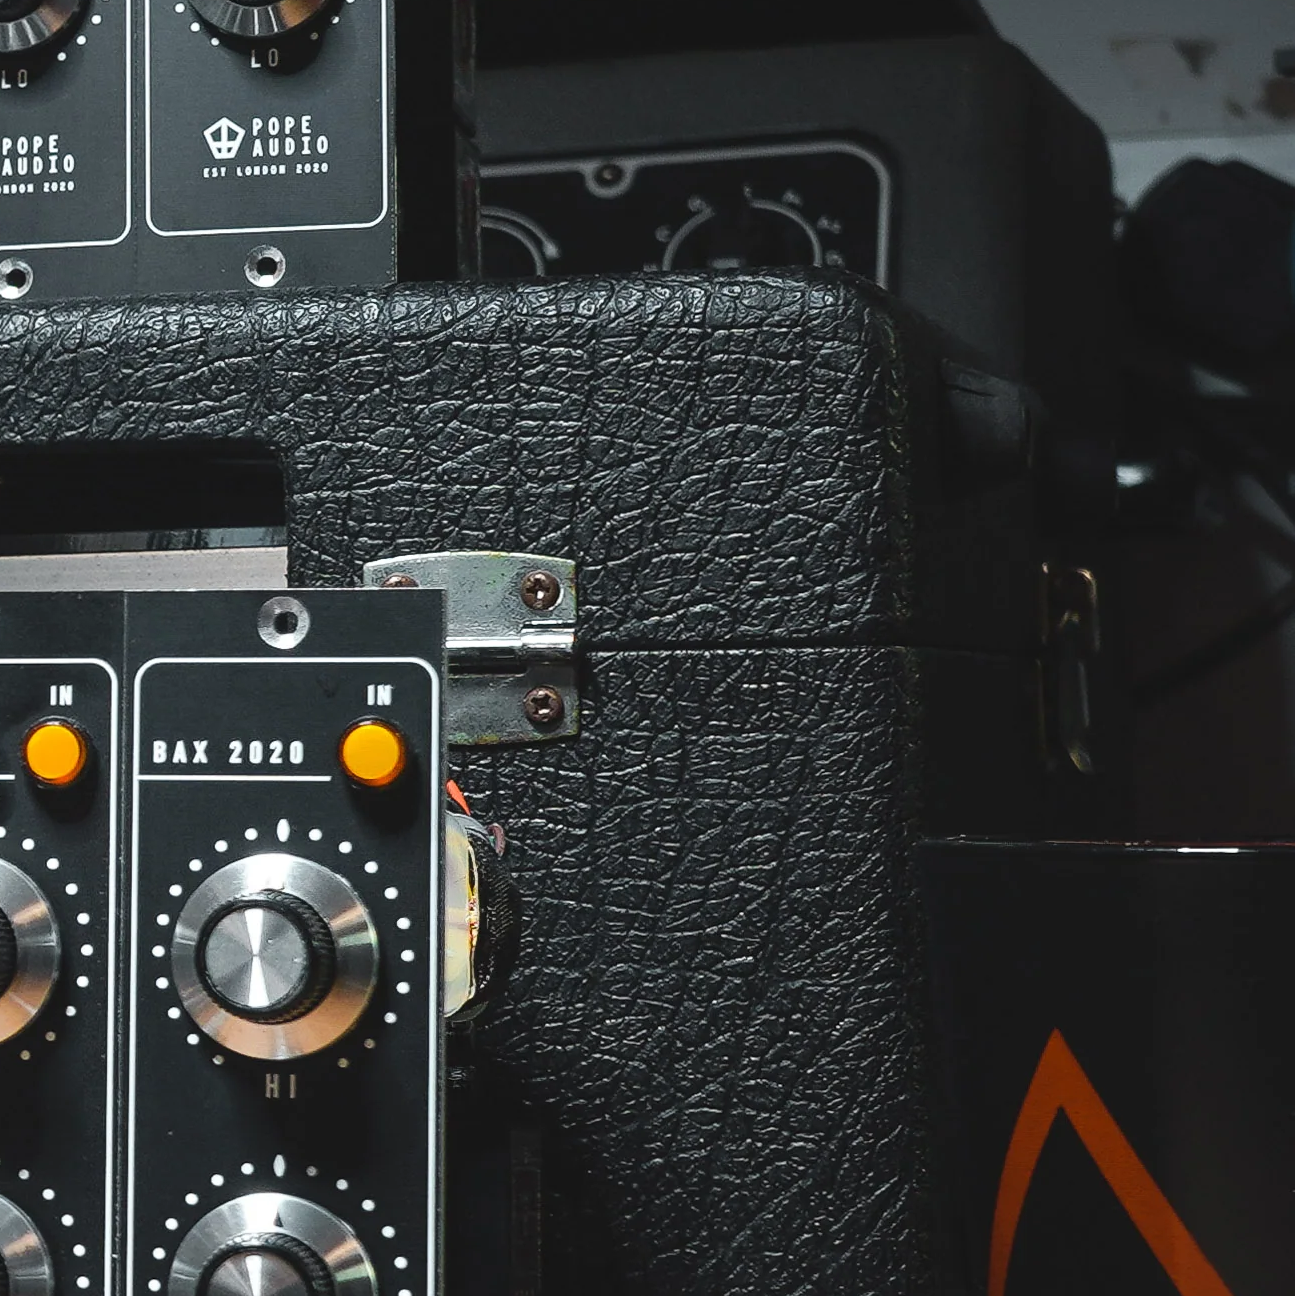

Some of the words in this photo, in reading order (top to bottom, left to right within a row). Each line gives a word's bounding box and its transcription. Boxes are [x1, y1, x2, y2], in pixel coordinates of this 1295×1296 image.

[250, 47, 279, 69] LO
[0, 68, 28, 90] LO
[252, 115, 312, 137] POPE
[2, 134, 59, 156] POPE
[252, 135, 329, 158] AUDIO
[1, 153, 75, 177] AUDIO
[49, 684, 73, 706] IN
[367, 684, 394, 706] IN
[152, 739, 208, 764] BAX
[228, 739, 304, 765] 2020
[265, 1073, 297, 1099] HI
